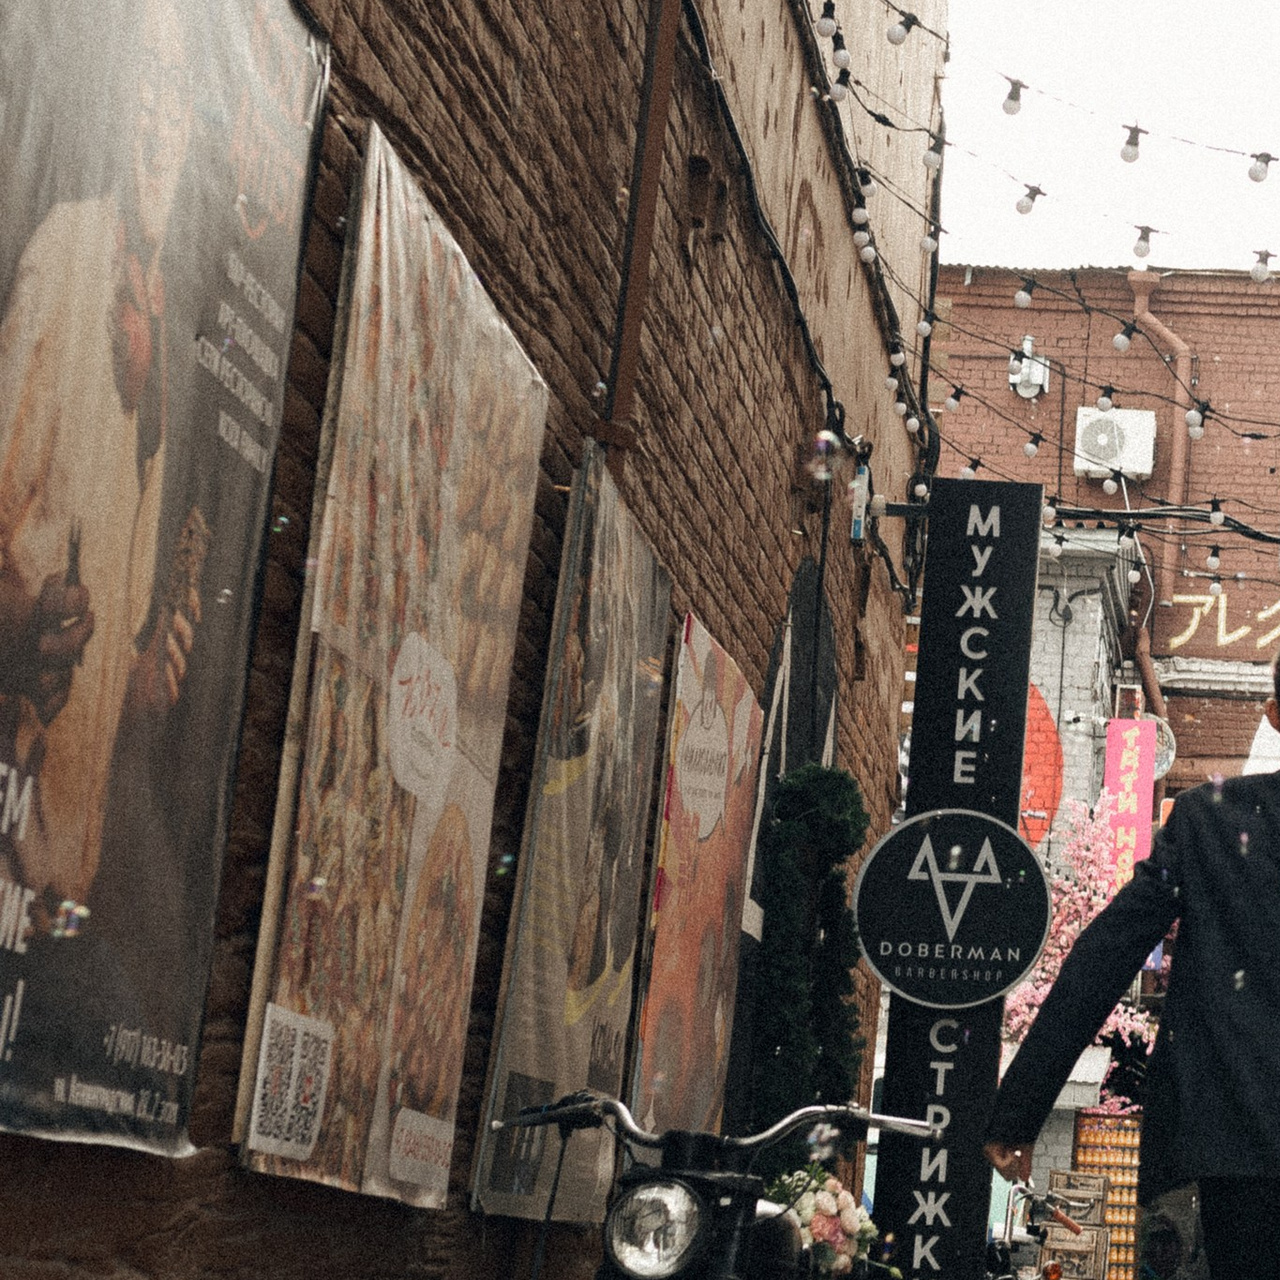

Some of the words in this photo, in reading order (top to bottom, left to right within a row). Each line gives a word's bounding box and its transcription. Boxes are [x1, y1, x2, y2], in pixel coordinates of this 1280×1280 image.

[953, 504, 1001, 783] МУЖСКИЕ
[879, 941, 1020, 962] DOBERMAN
[894, 966, 1002, 982] BARBERSHOP
